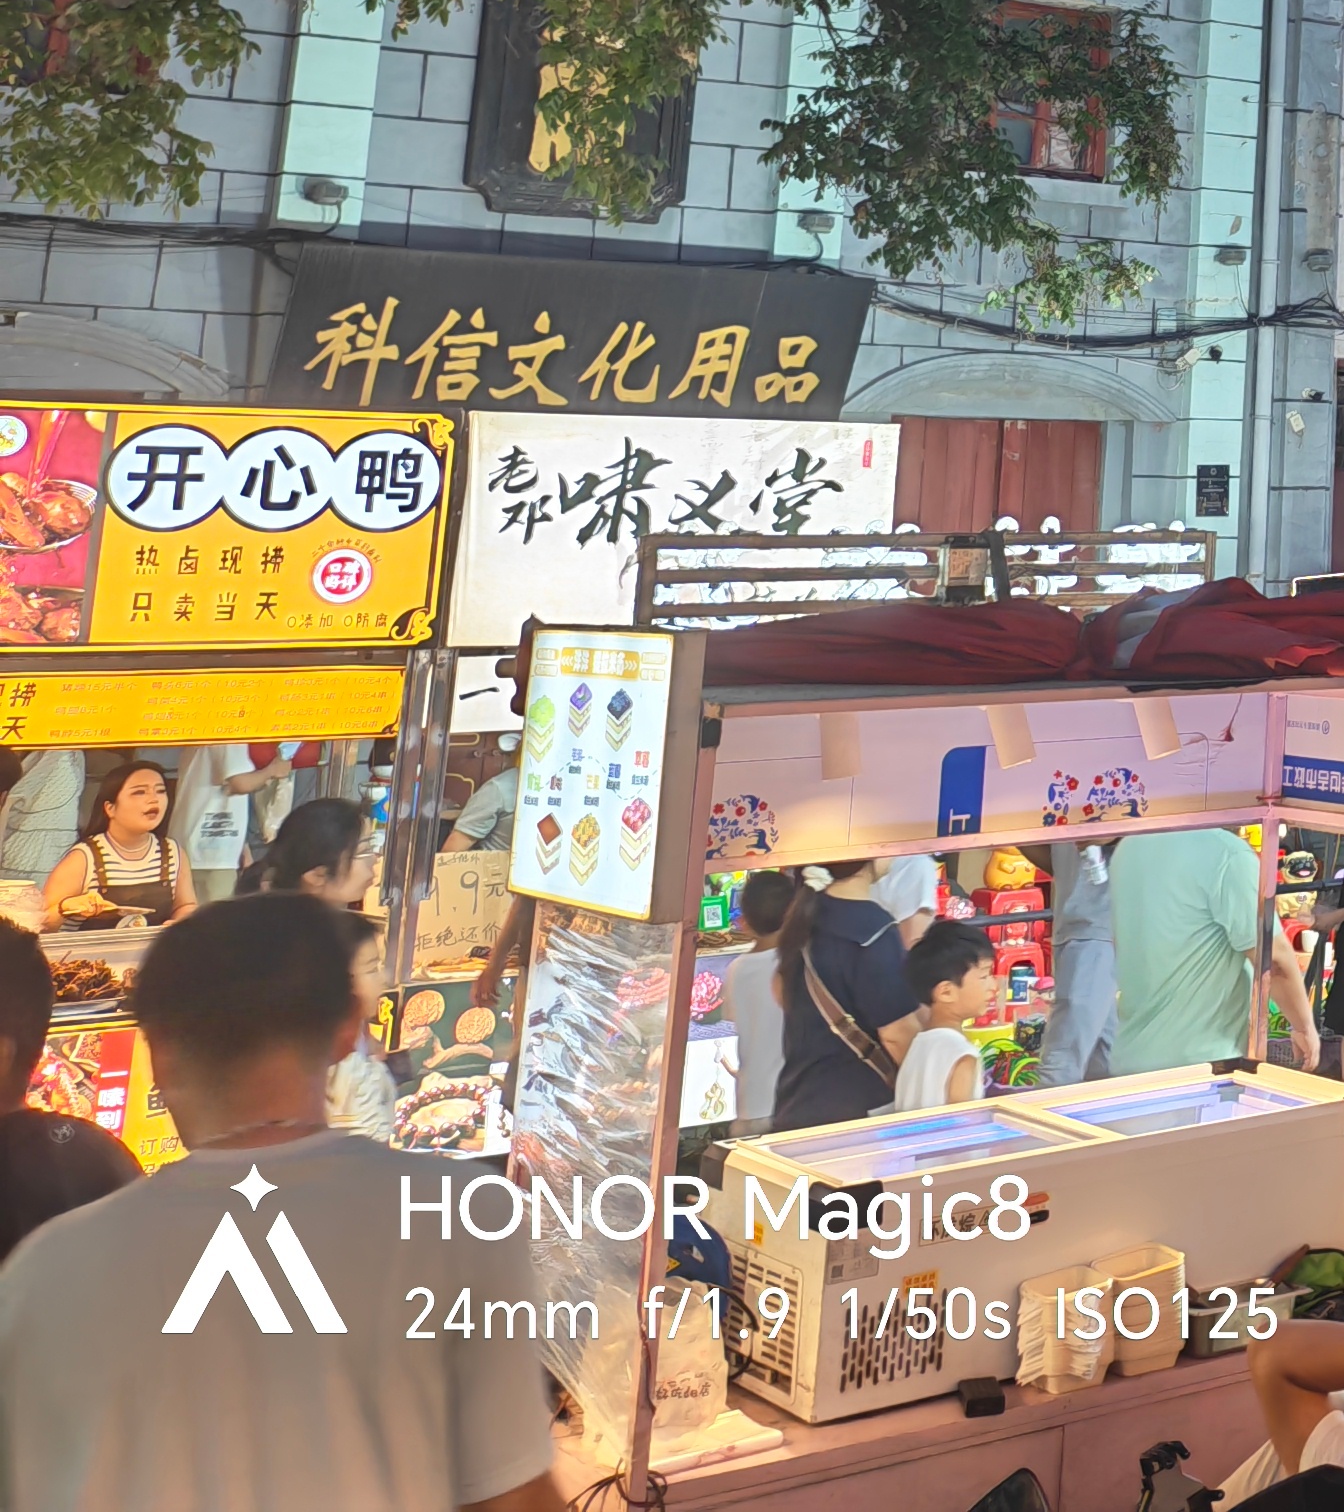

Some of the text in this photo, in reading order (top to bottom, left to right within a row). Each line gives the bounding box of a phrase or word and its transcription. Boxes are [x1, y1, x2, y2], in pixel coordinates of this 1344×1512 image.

[303, 296, 821, 408] 科信文化用品
[127, 444, 424, 514] 开心鸭
[134, 544, 285, 576] 热卤现捞
[130, 591, 279, 623] 只卖当天
[415, 921, 502, 952] 拒绝还价
